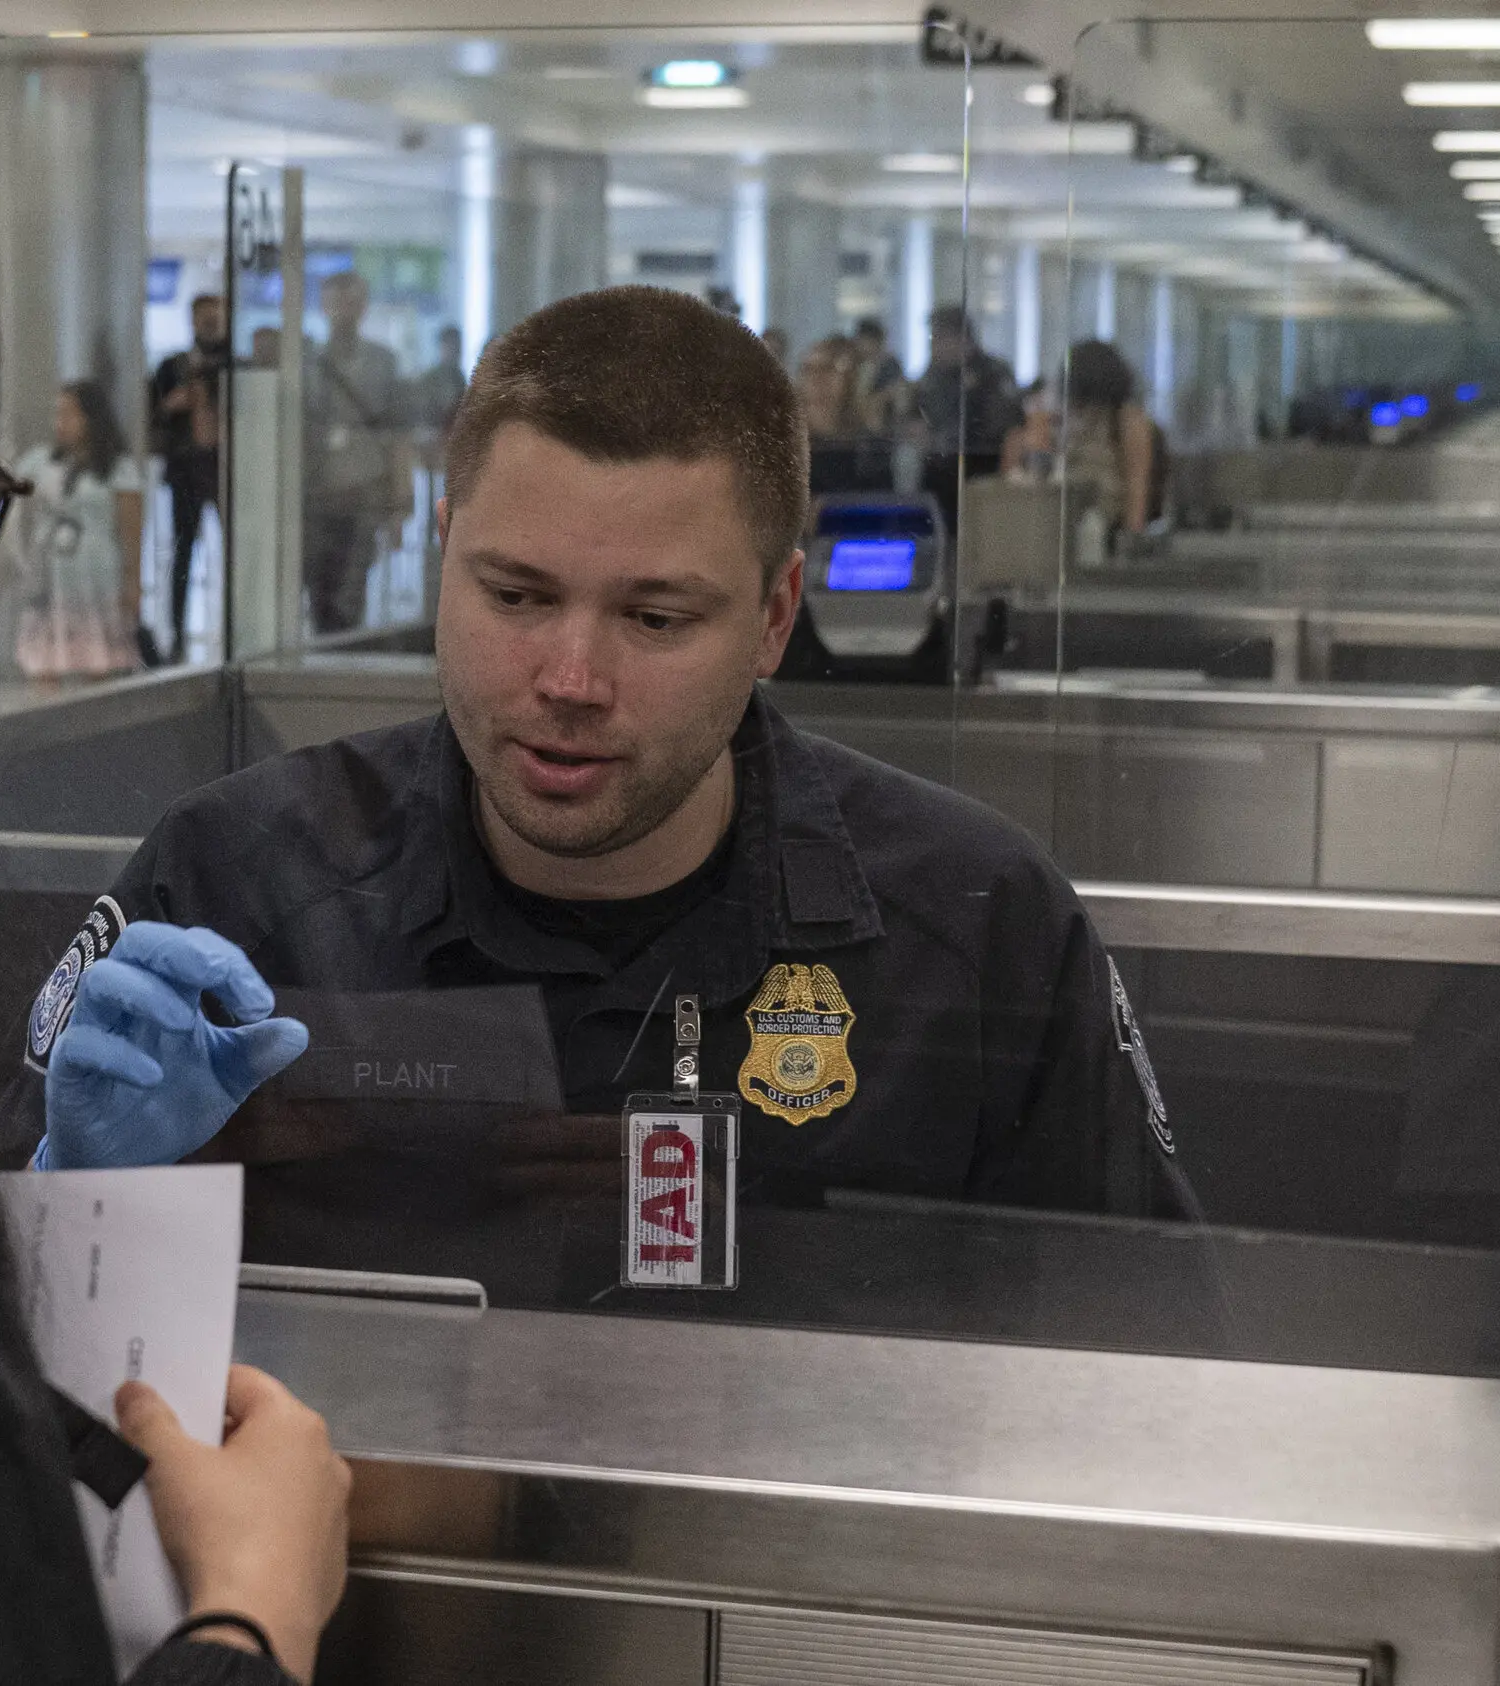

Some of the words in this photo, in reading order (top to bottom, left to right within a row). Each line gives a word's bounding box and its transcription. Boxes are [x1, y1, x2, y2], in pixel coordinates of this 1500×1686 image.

[756, 1023, 790, 1033] BORDER
[791, 1024, 842, 1034] PROTECTION
[758, 1013, 776, 1023] U.S.
[777, 1013, 820, 1025] CUSTOMS
[823, 1015, 842, 1025] AND
[354, 1061, 457, 1088] PLANT
[767, 1087, 830, 1108] OFFICER
[640, 1130, 695, 1262] IAD
